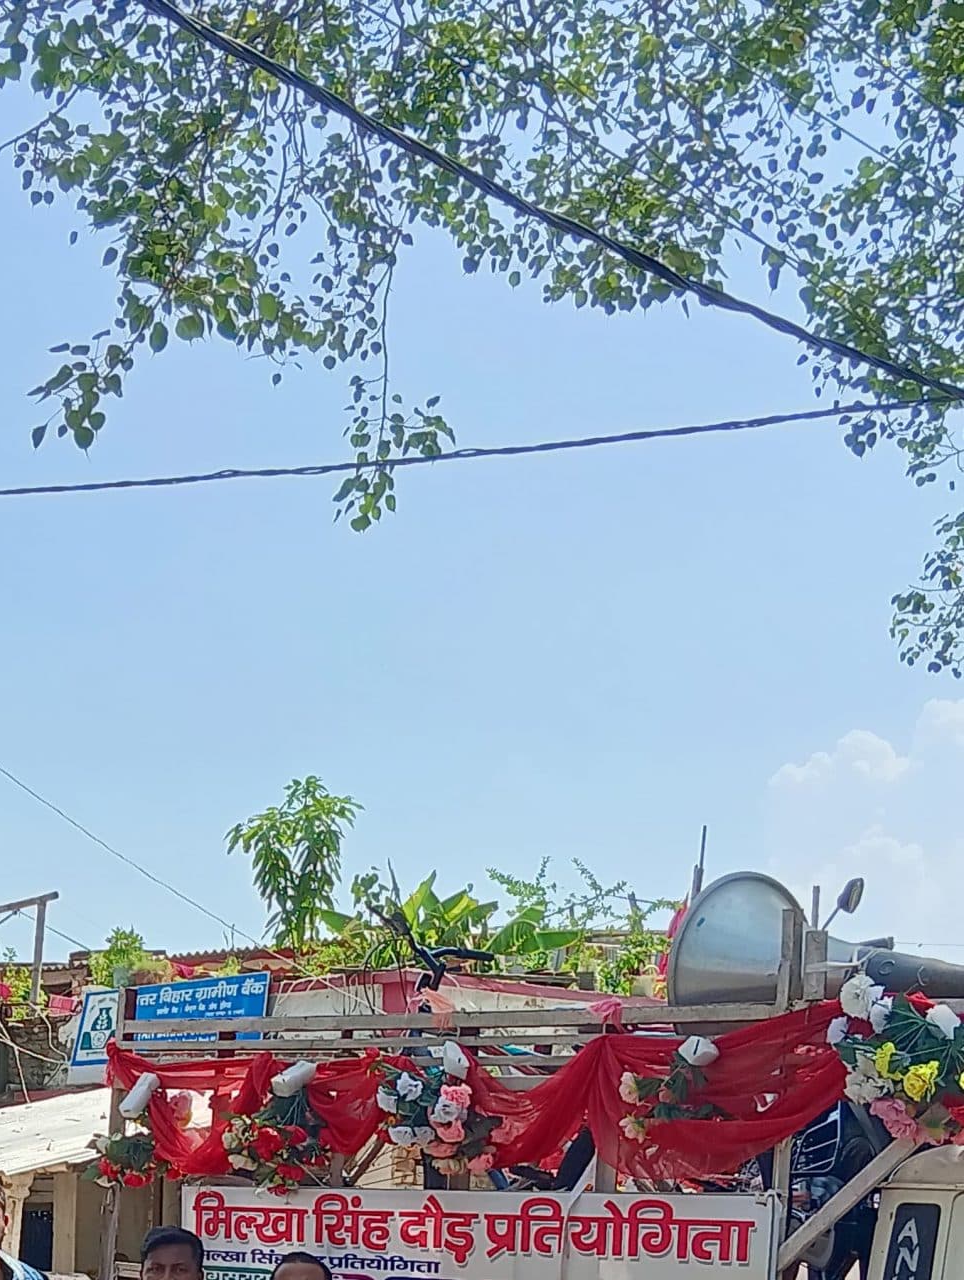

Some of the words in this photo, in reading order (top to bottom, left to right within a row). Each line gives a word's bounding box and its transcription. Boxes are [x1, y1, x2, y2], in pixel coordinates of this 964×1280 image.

[137, 993, 157, 1006] त्तर
[160, 987, 193, 1004] बिहार
[196, 981, 239, 1002] ग्रामीण
[193, 1190, 308, 1245] मिल्खा
[313, 1193, 394, 1251] सिंह
[399, 1195, 478, 1264] दौड़
[484, 1197, 756, 1263] प्रतियोगिता
[204, 1250, 247, 1263] ल्खा
[329, 1254, 441, 1273] प्रतियोगिता
